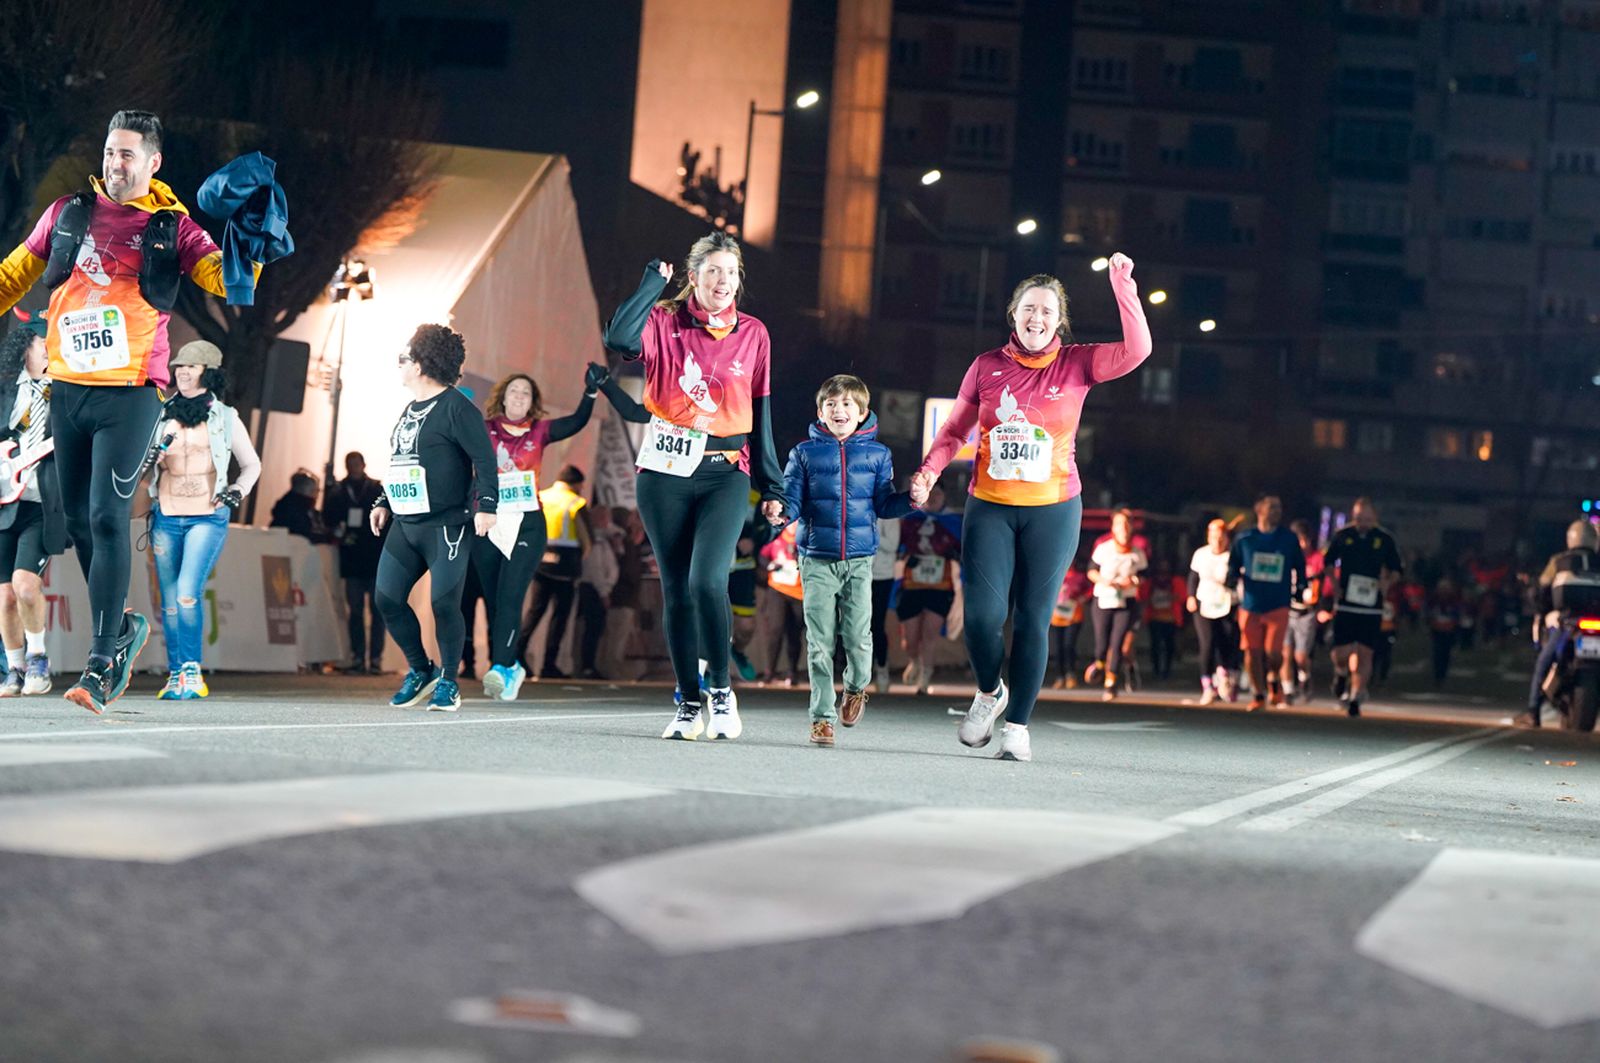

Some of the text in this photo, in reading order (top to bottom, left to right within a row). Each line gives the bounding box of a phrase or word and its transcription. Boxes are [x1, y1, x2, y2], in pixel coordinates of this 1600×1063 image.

[82, 256, 100, 274] 43
[73, 329, 113, 352] 5756
[690, 384, 706, 401] 43
[656, 433, 692, 456] 3341
[1000, 442, 1040, 460] 3340
